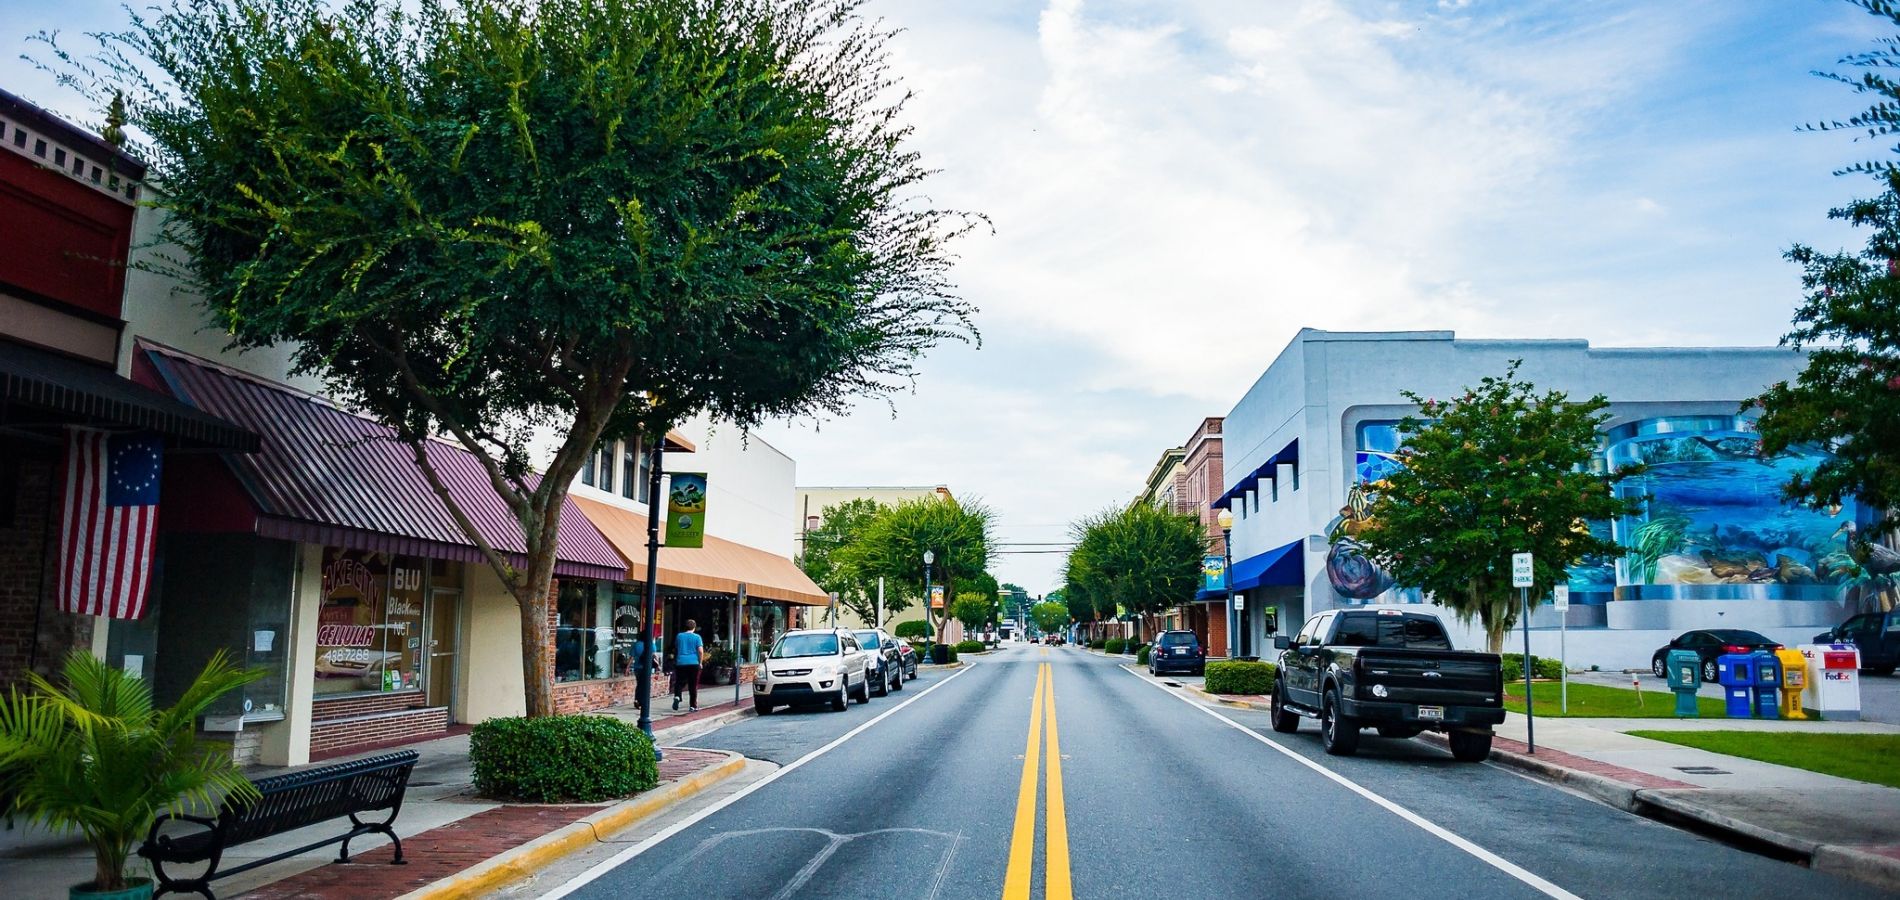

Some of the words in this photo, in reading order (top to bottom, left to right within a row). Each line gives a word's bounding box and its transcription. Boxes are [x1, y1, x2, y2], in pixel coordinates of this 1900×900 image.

[395, 567, 420, 591] BLU
[352, 562, 379, 625] CITY
[317, 624, 375, 646] CELLULAR
[617, 626, 627, 634] Mini
[628, 626, 638, 634] Mall
[1825, 671, 1849, 680] FedEx
